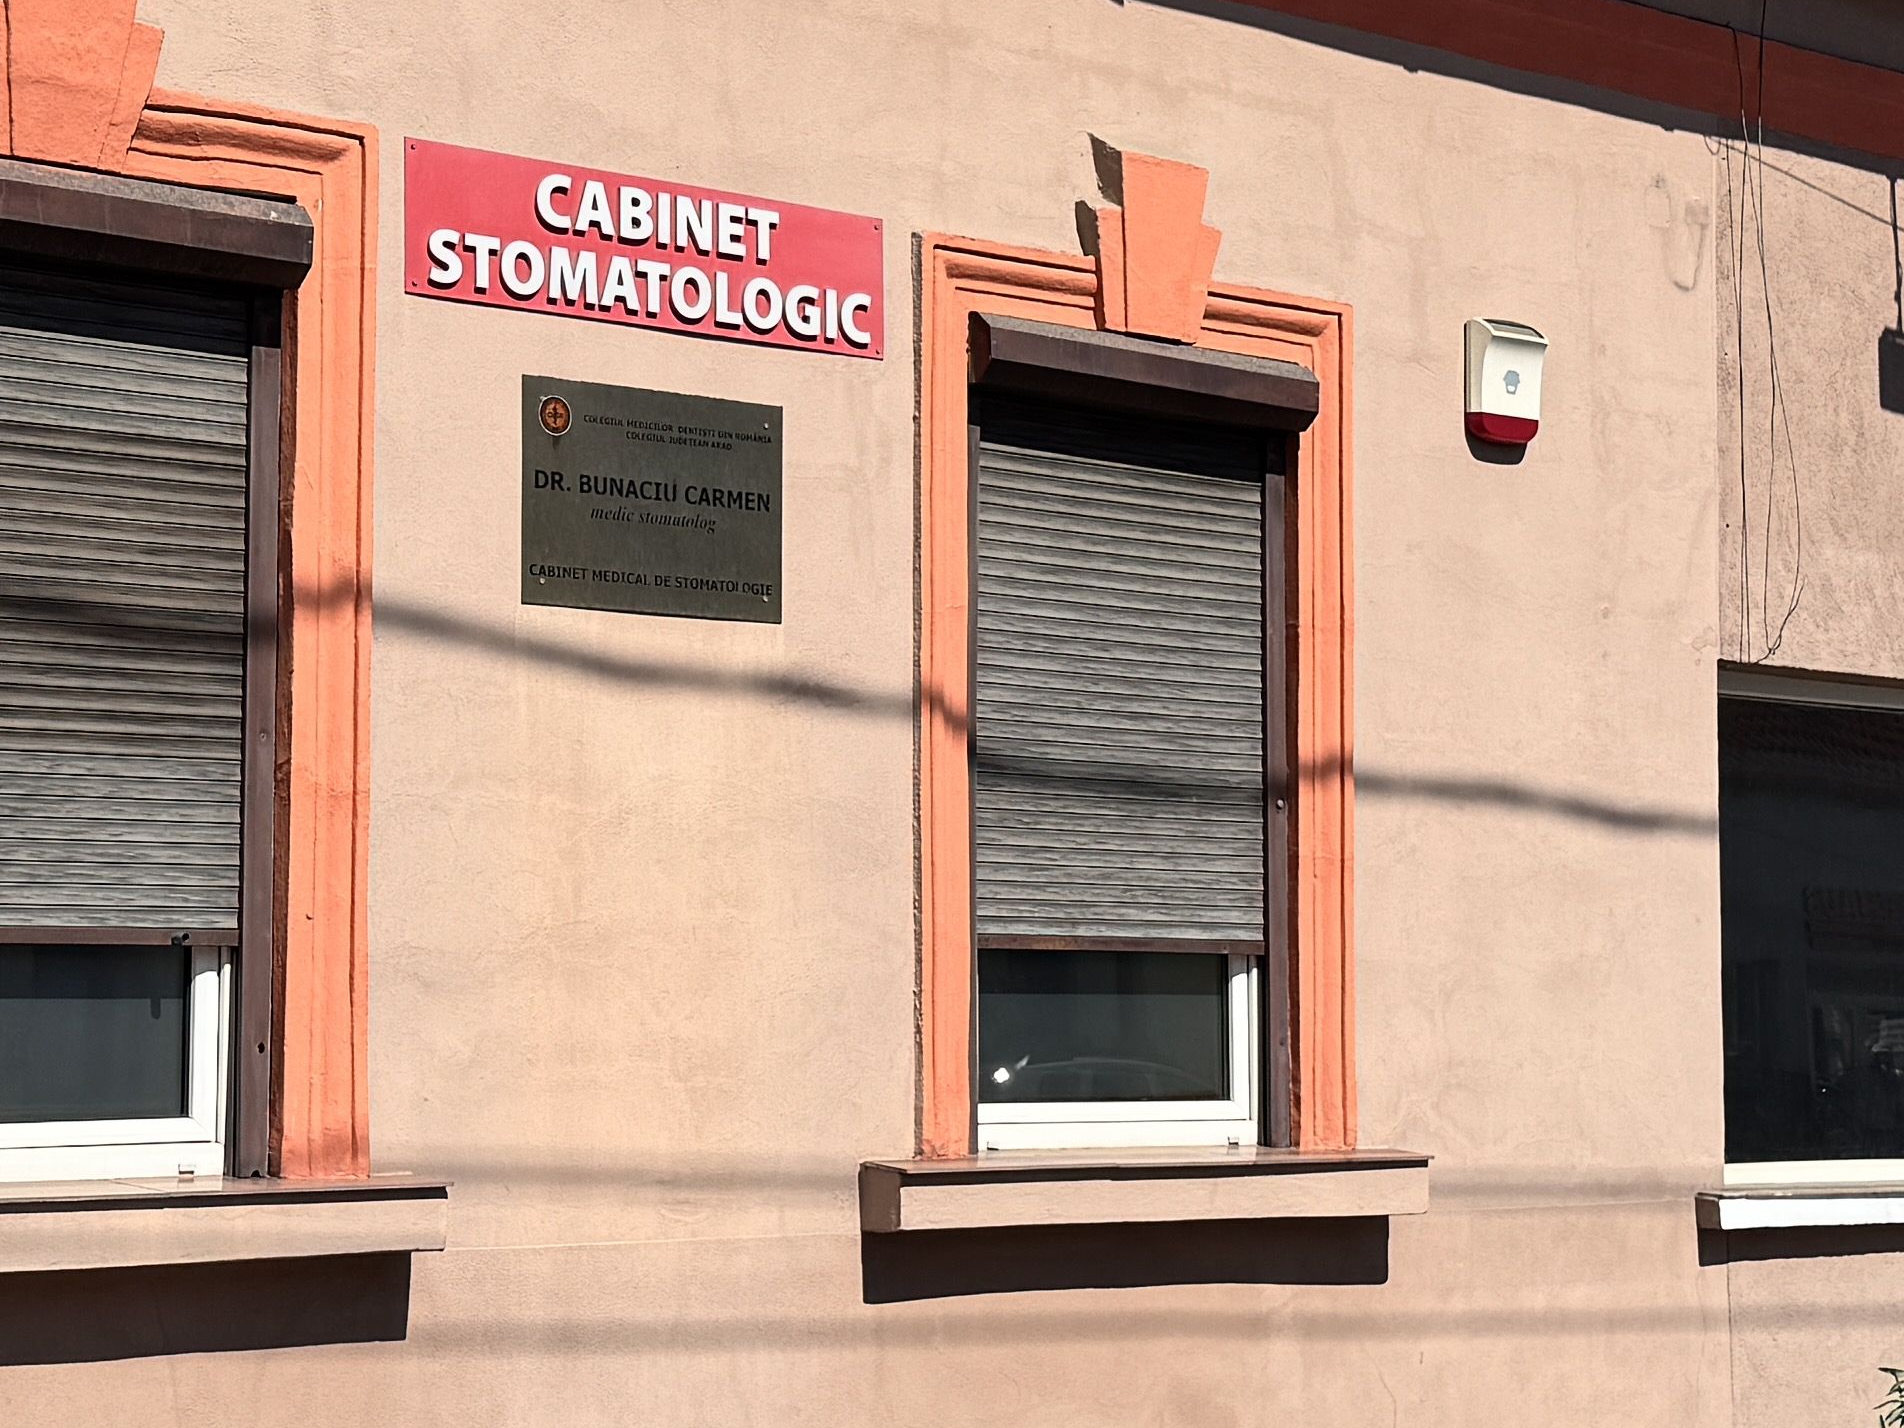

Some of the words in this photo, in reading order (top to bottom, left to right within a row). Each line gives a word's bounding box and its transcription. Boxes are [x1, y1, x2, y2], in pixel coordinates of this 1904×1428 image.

[534, 173, 780, 264] CABINET
[426, 228, 873, 347] STOMATOLOGIC
[534, 469, 572, 492] DR.
[579, 474, 678, 502] BUNACIU
[684, 486, 770, 512] CARMEN
[590, 505, 634, 522] medic
[639, 511, 717, 534] stomatolog
[529, 564, 588, 580] CABINET
[592, 569, 651, 586] MEDICAL
[654, 575, 672, 588] DE
[675, 576, 773, 597] STOMATOLOGIE
